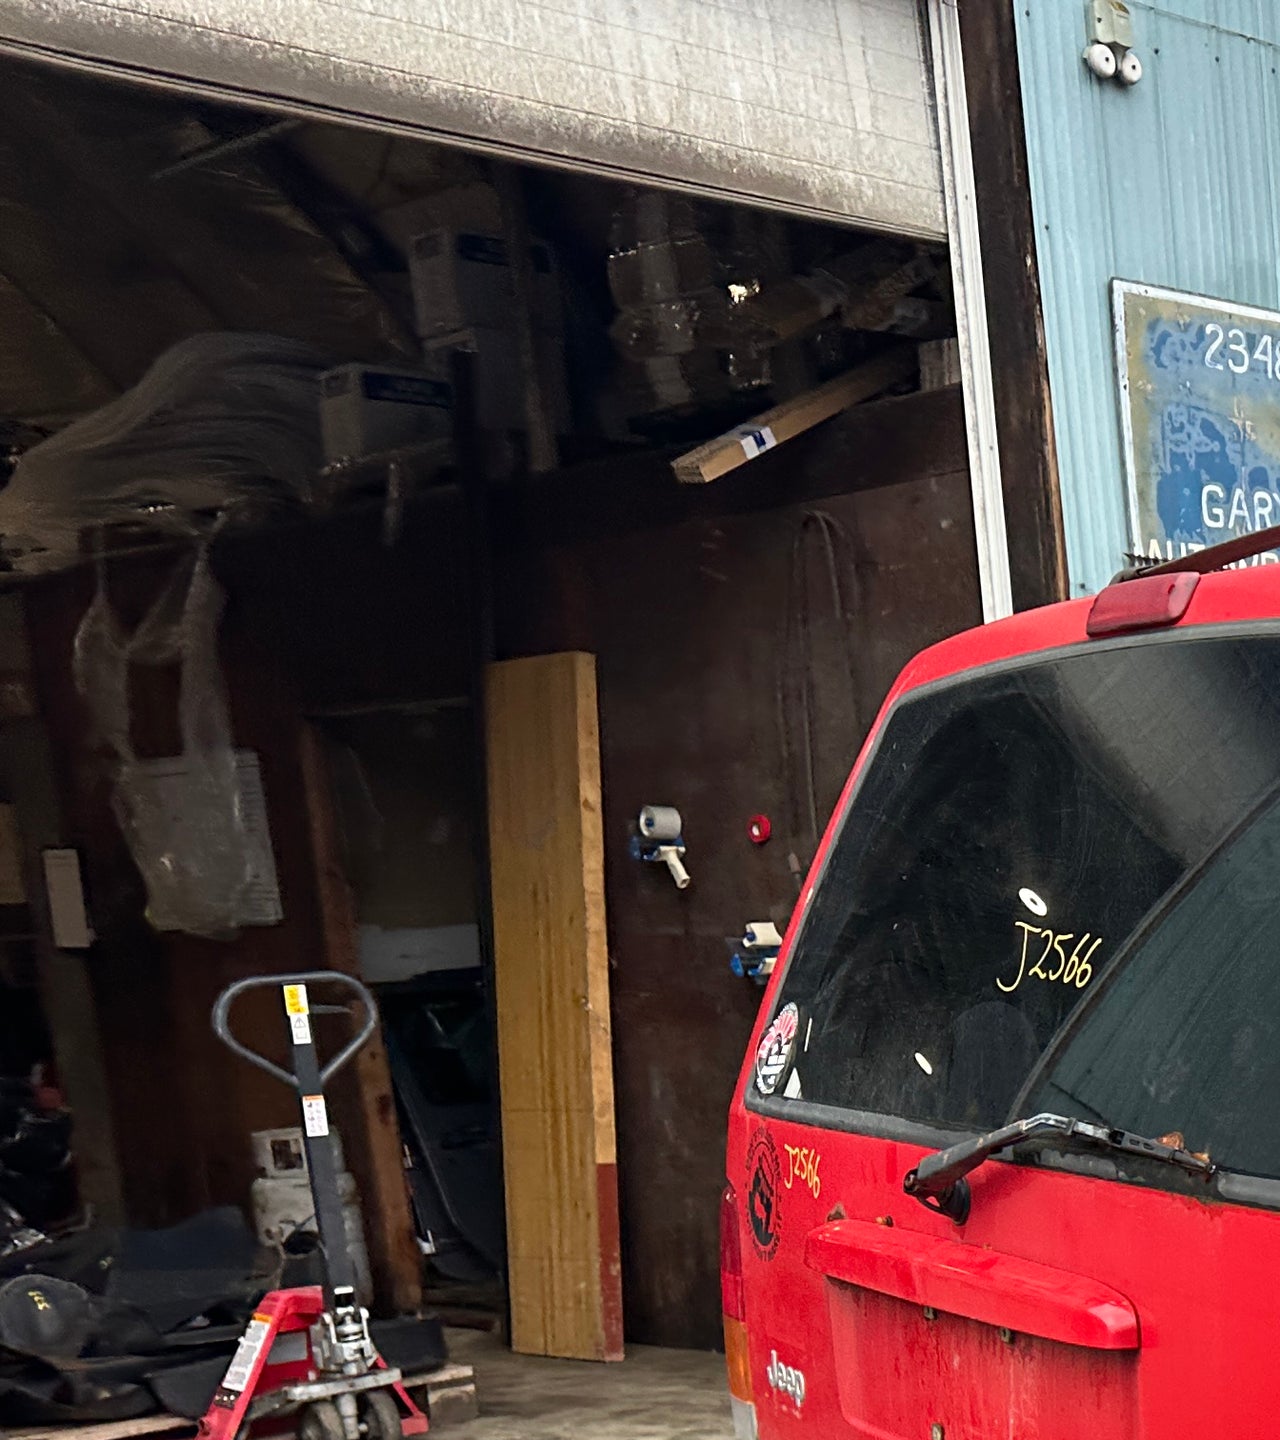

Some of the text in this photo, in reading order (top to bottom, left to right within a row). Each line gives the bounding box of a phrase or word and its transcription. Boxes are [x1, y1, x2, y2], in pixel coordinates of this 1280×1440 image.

[995, 920, 1103, 993] J2566
[783, 1142, 822, 1200] J2566
[766, 1348, 806, 1408] Jeep
